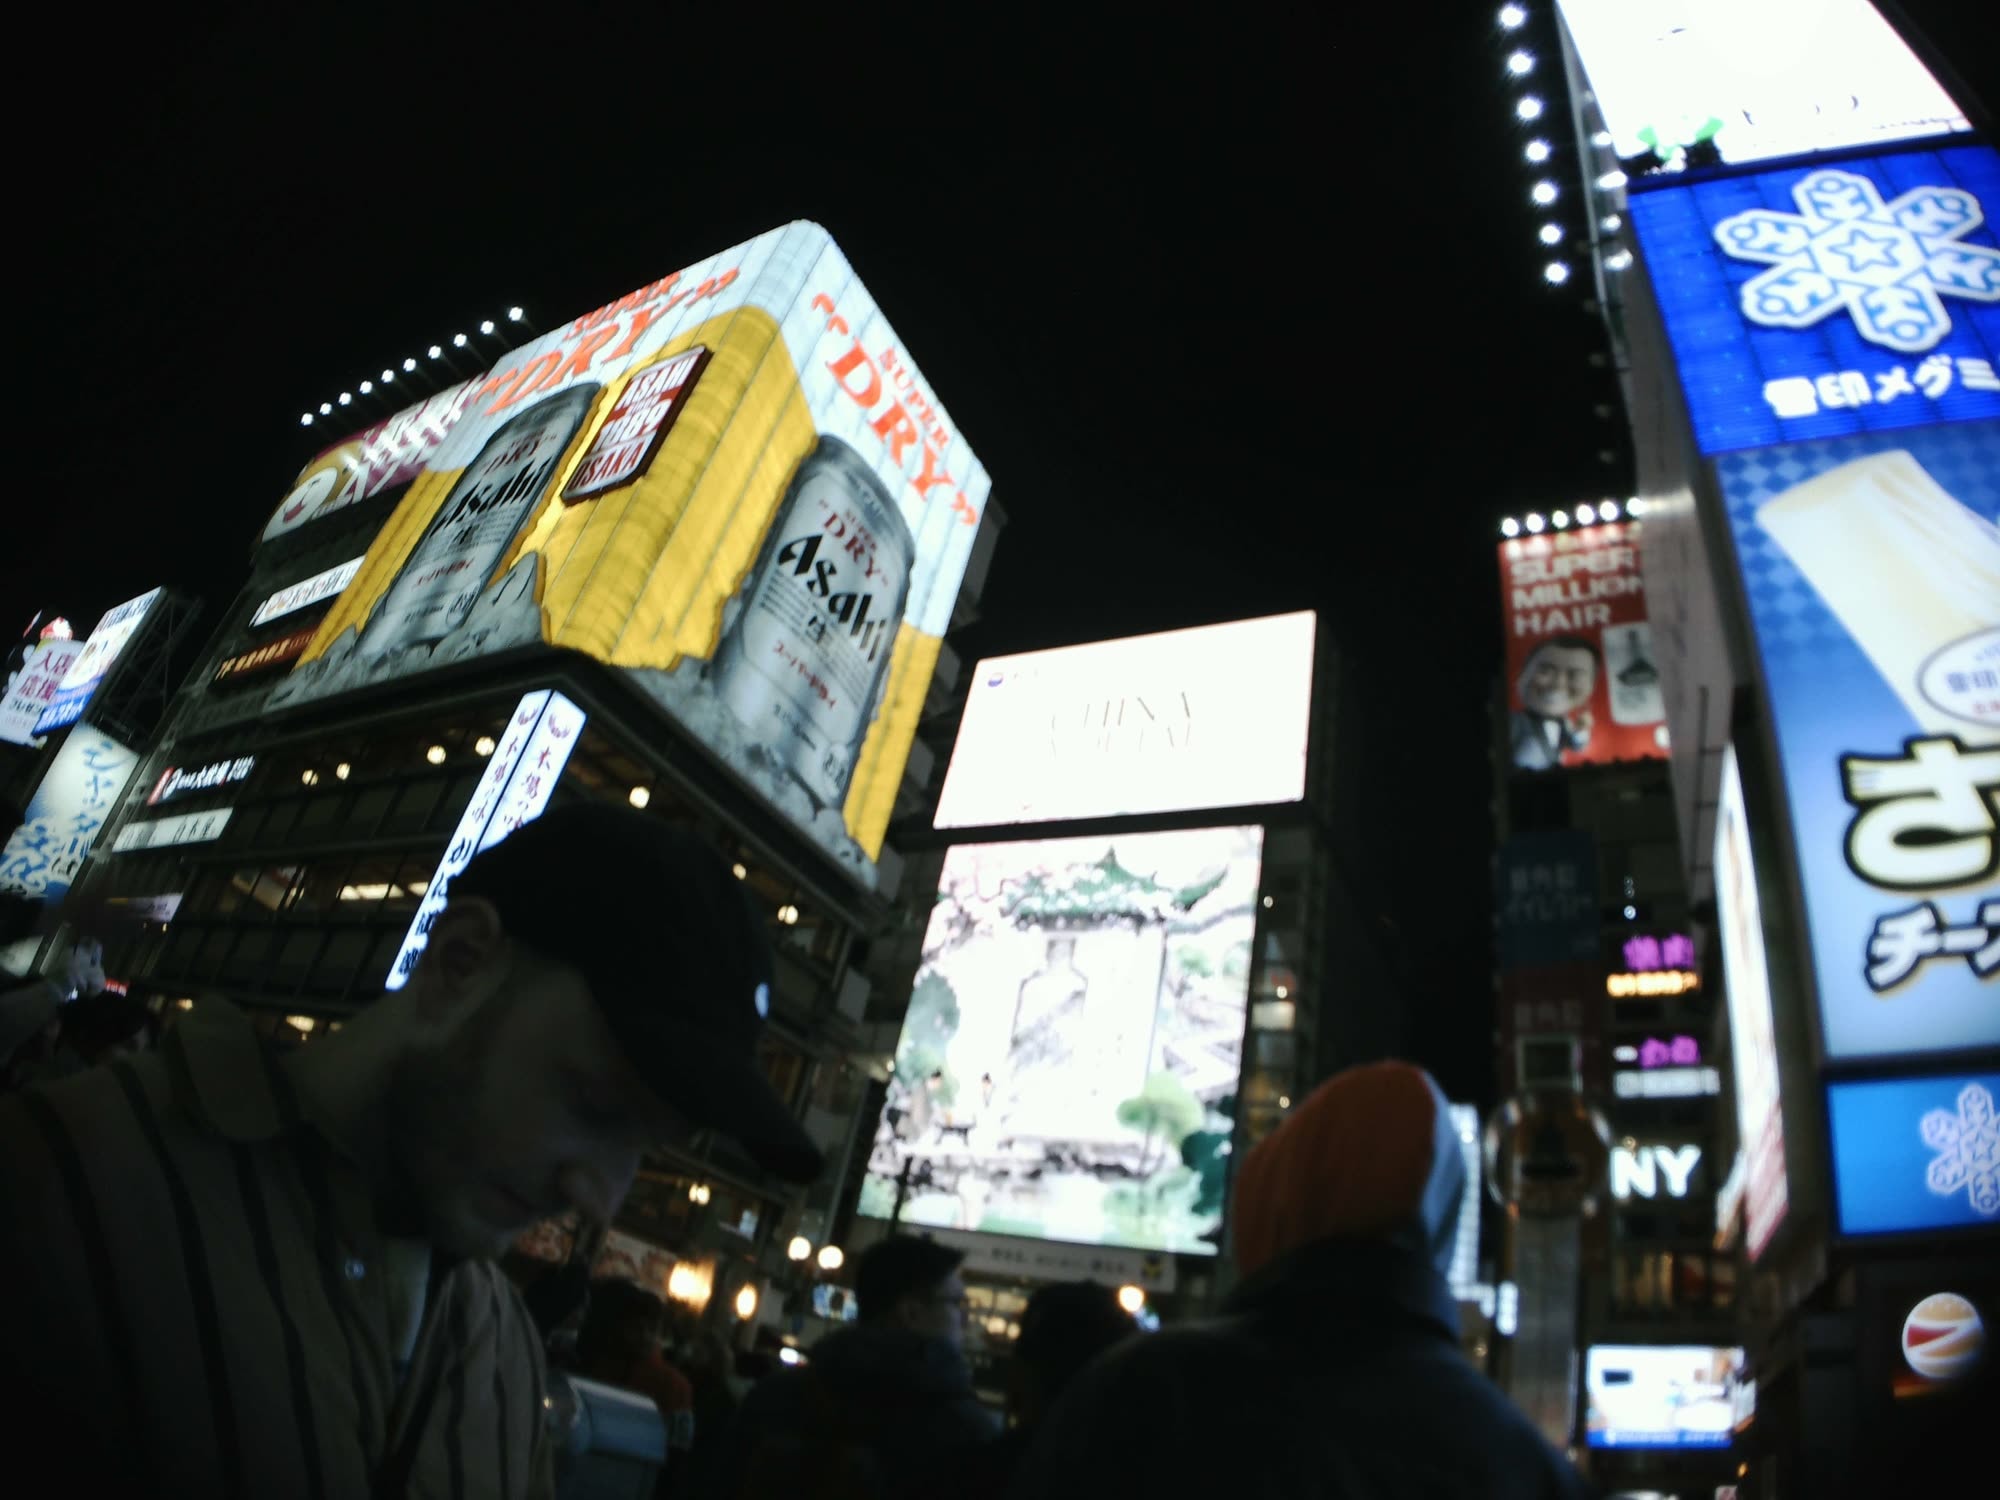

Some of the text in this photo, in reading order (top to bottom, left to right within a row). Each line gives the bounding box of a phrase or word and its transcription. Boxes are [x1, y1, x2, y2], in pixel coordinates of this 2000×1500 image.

[614, 355, 699, 412] ASAHI
[877, 348, 949, 448] SUPER
[588, 399, 672, 452] 1889
[567, 441, 645, 491] OSAKA
[1510, 548, 1635, 585] SUPER
[777, 534, 886, 663] Asahi
[1515, 603, 1611, 638] HAIR
[1610, 1144, 1702, 1198] NY
